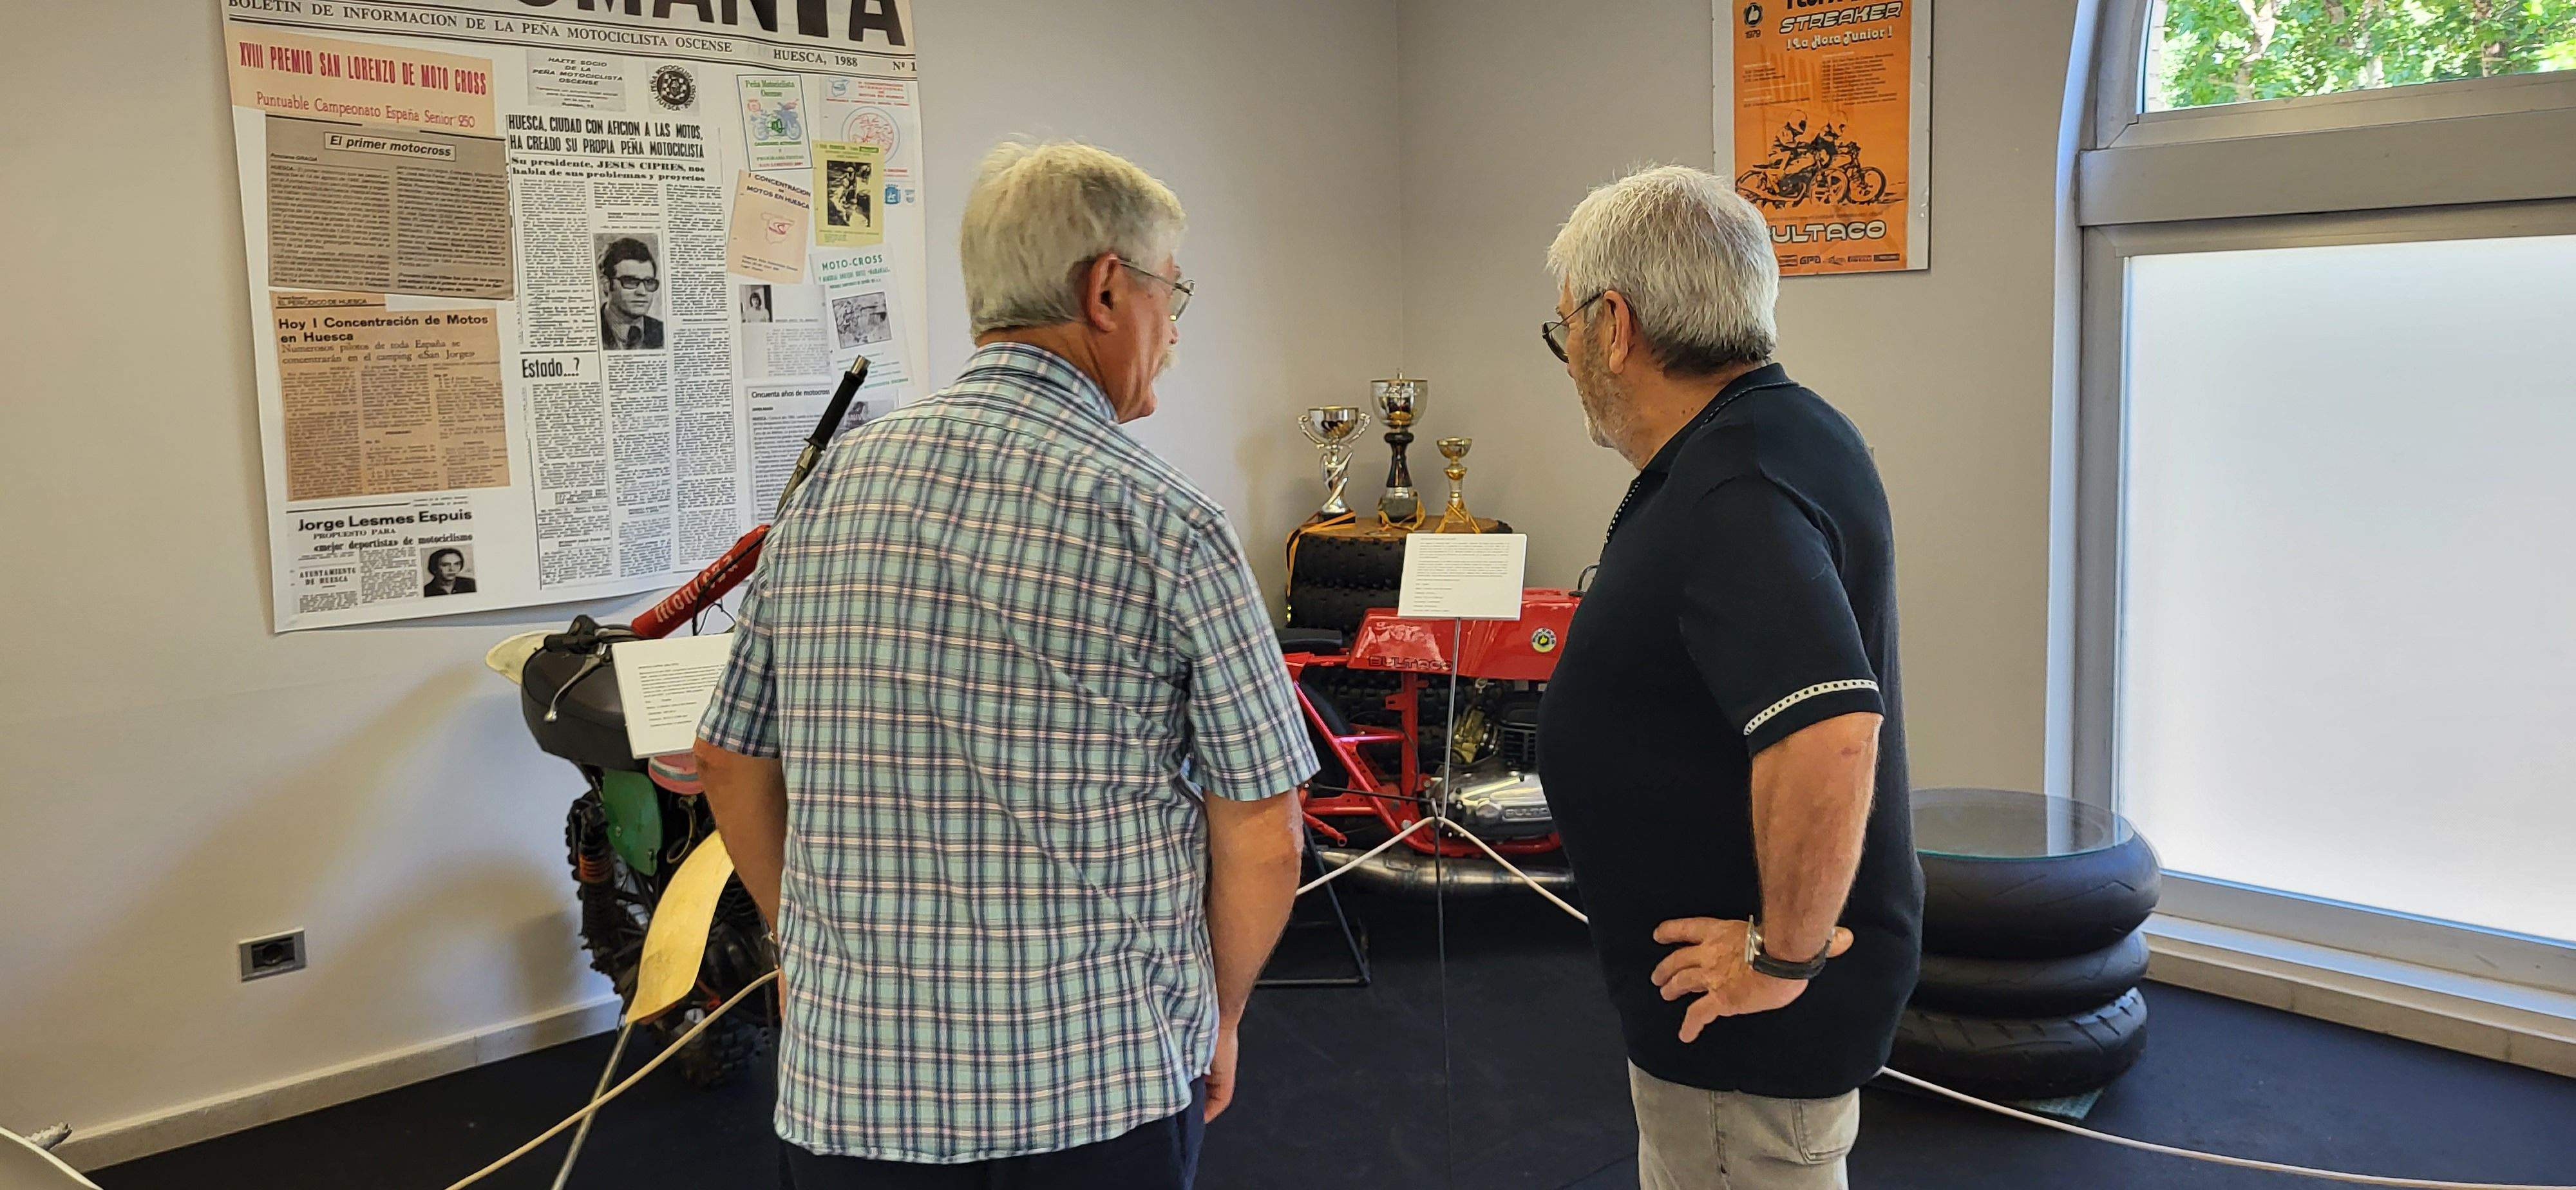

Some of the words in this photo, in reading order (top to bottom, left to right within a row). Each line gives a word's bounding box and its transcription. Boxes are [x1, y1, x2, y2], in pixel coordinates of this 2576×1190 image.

[1779, 1, 1903, 34] STREAKER
[228, 0, 301, 13] BOLETIN
[312, 5, 334, 16] DE
[344, 6, 457, 27] INFORMACION
[466, 18, 486, 30] DE
[495, 20, 513, 32] LA
[522, 21, 560, 37] PEÑA
[567, 27, 668, 47] MOTOCICLISTA
[676, 35, 732, 53] OSCENSE
[773, 49, 827, 65] HUESCA,
[835, 55, 858, 68] 1988
[1811, 33, 1841, 50] Hora
[240, 42, 263, 68] XVIII
[270, 46, 313, 75] PREMIO
[319, 52, 341, 77] SAN
[347, 55, 396, 84] LORENZO
[402, 62, 415, 86] DE
[421, 64, 449, 90] MOTO
[455, 69, 486, 95] CROSS
[560, 71, 623, 80] MOTOCICLISTA
[257, 91, 309, 110] Puntuable
[314, 98, 381, 118] Campeonato
[386, 106, 419, 123] España
[424, 109, 456, 126] Senior
[509, 114, 547, 133] HUESCA,
[550, 117, 582, 133] CIUDAD
[585, 119, 603, 135] CON
[608, 120, 640, 136] AFICION
[645, 122, 650, 137] A
[655, 122, 670, 137] LAS
[330, 135, 342, 146] El
[346, 137, 386, 150] primer
[390, 142, 451, 156] motocross
[510, 135, 523, 150] HA
[527, 135, 561, 151] CREADO
[566, 138, 578, 153] SU
[583, 138, 614, 154] PROPIA
[621, 137, 644, 155] PEÑA
[650, 141, 704, 158] MOTOCICLISTA
[513, 167, 547, 176] habla
[587, 170, 647, 179] problemas
[597, 161, 636, 169] JESUS
[746, 185, 773, 197] MOTOS
[785, 196, 810, 209] HUESCA
[1770, 220, 1887, 244] ULTACO
[822, 254, 883, 270] MOTO-CROSS
[279, 318, 306, 331] Hoy
[324, 316, 419, 328] Concentración
[424, 316, 440, 325] de
[447, 314, 488, 325] Motos
[280, 334, 297, 343] en
[303, 332, 354, 341] Huesca
[374, 341, 386, 350] de
[415, 339, 446, 350] España
[298, 519, 345, 531] Jorge
[349, 515, 414, 527] Lesmes
[419, 509, 472, 524] Espuis
